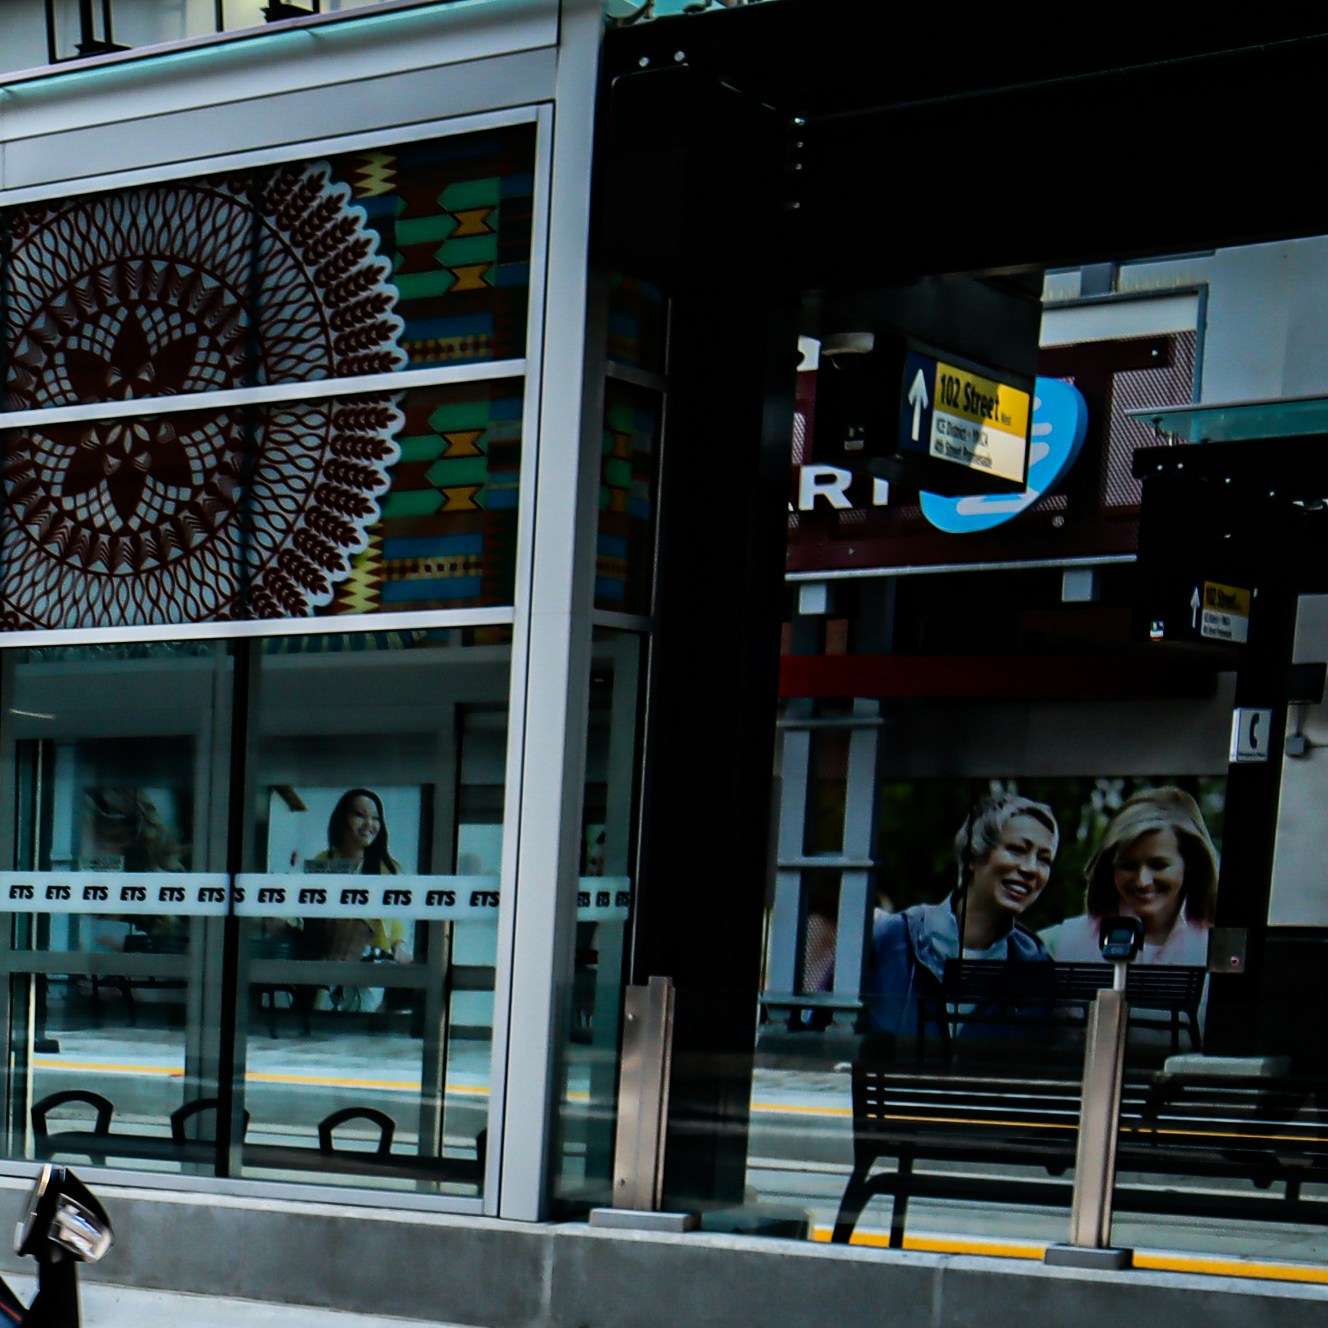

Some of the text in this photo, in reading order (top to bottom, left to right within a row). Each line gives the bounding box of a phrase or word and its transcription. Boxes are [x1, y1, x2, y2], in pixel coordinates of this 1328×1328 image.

[940, 374, 961, 409] 102
[964, 381, 1000, 422] Street
[9, 885, 34, 899] ETS
[46, 886, 71, 900] ETS
[83, 886, 108, 900] ETS
[120, 887, 146, 901] ETS
[159, 887, 185, 902] ETS
[198, 887, 225, 903] ETS
[258, 888, 286, 903] ETS
[298, 889, 327, 904] ETS
[340, 889, 369, 905] ETS
[382, 890, 412, 906] ETS
[425, 890, 456, 907] ETS
[469, 891, 500, 907] ETS
